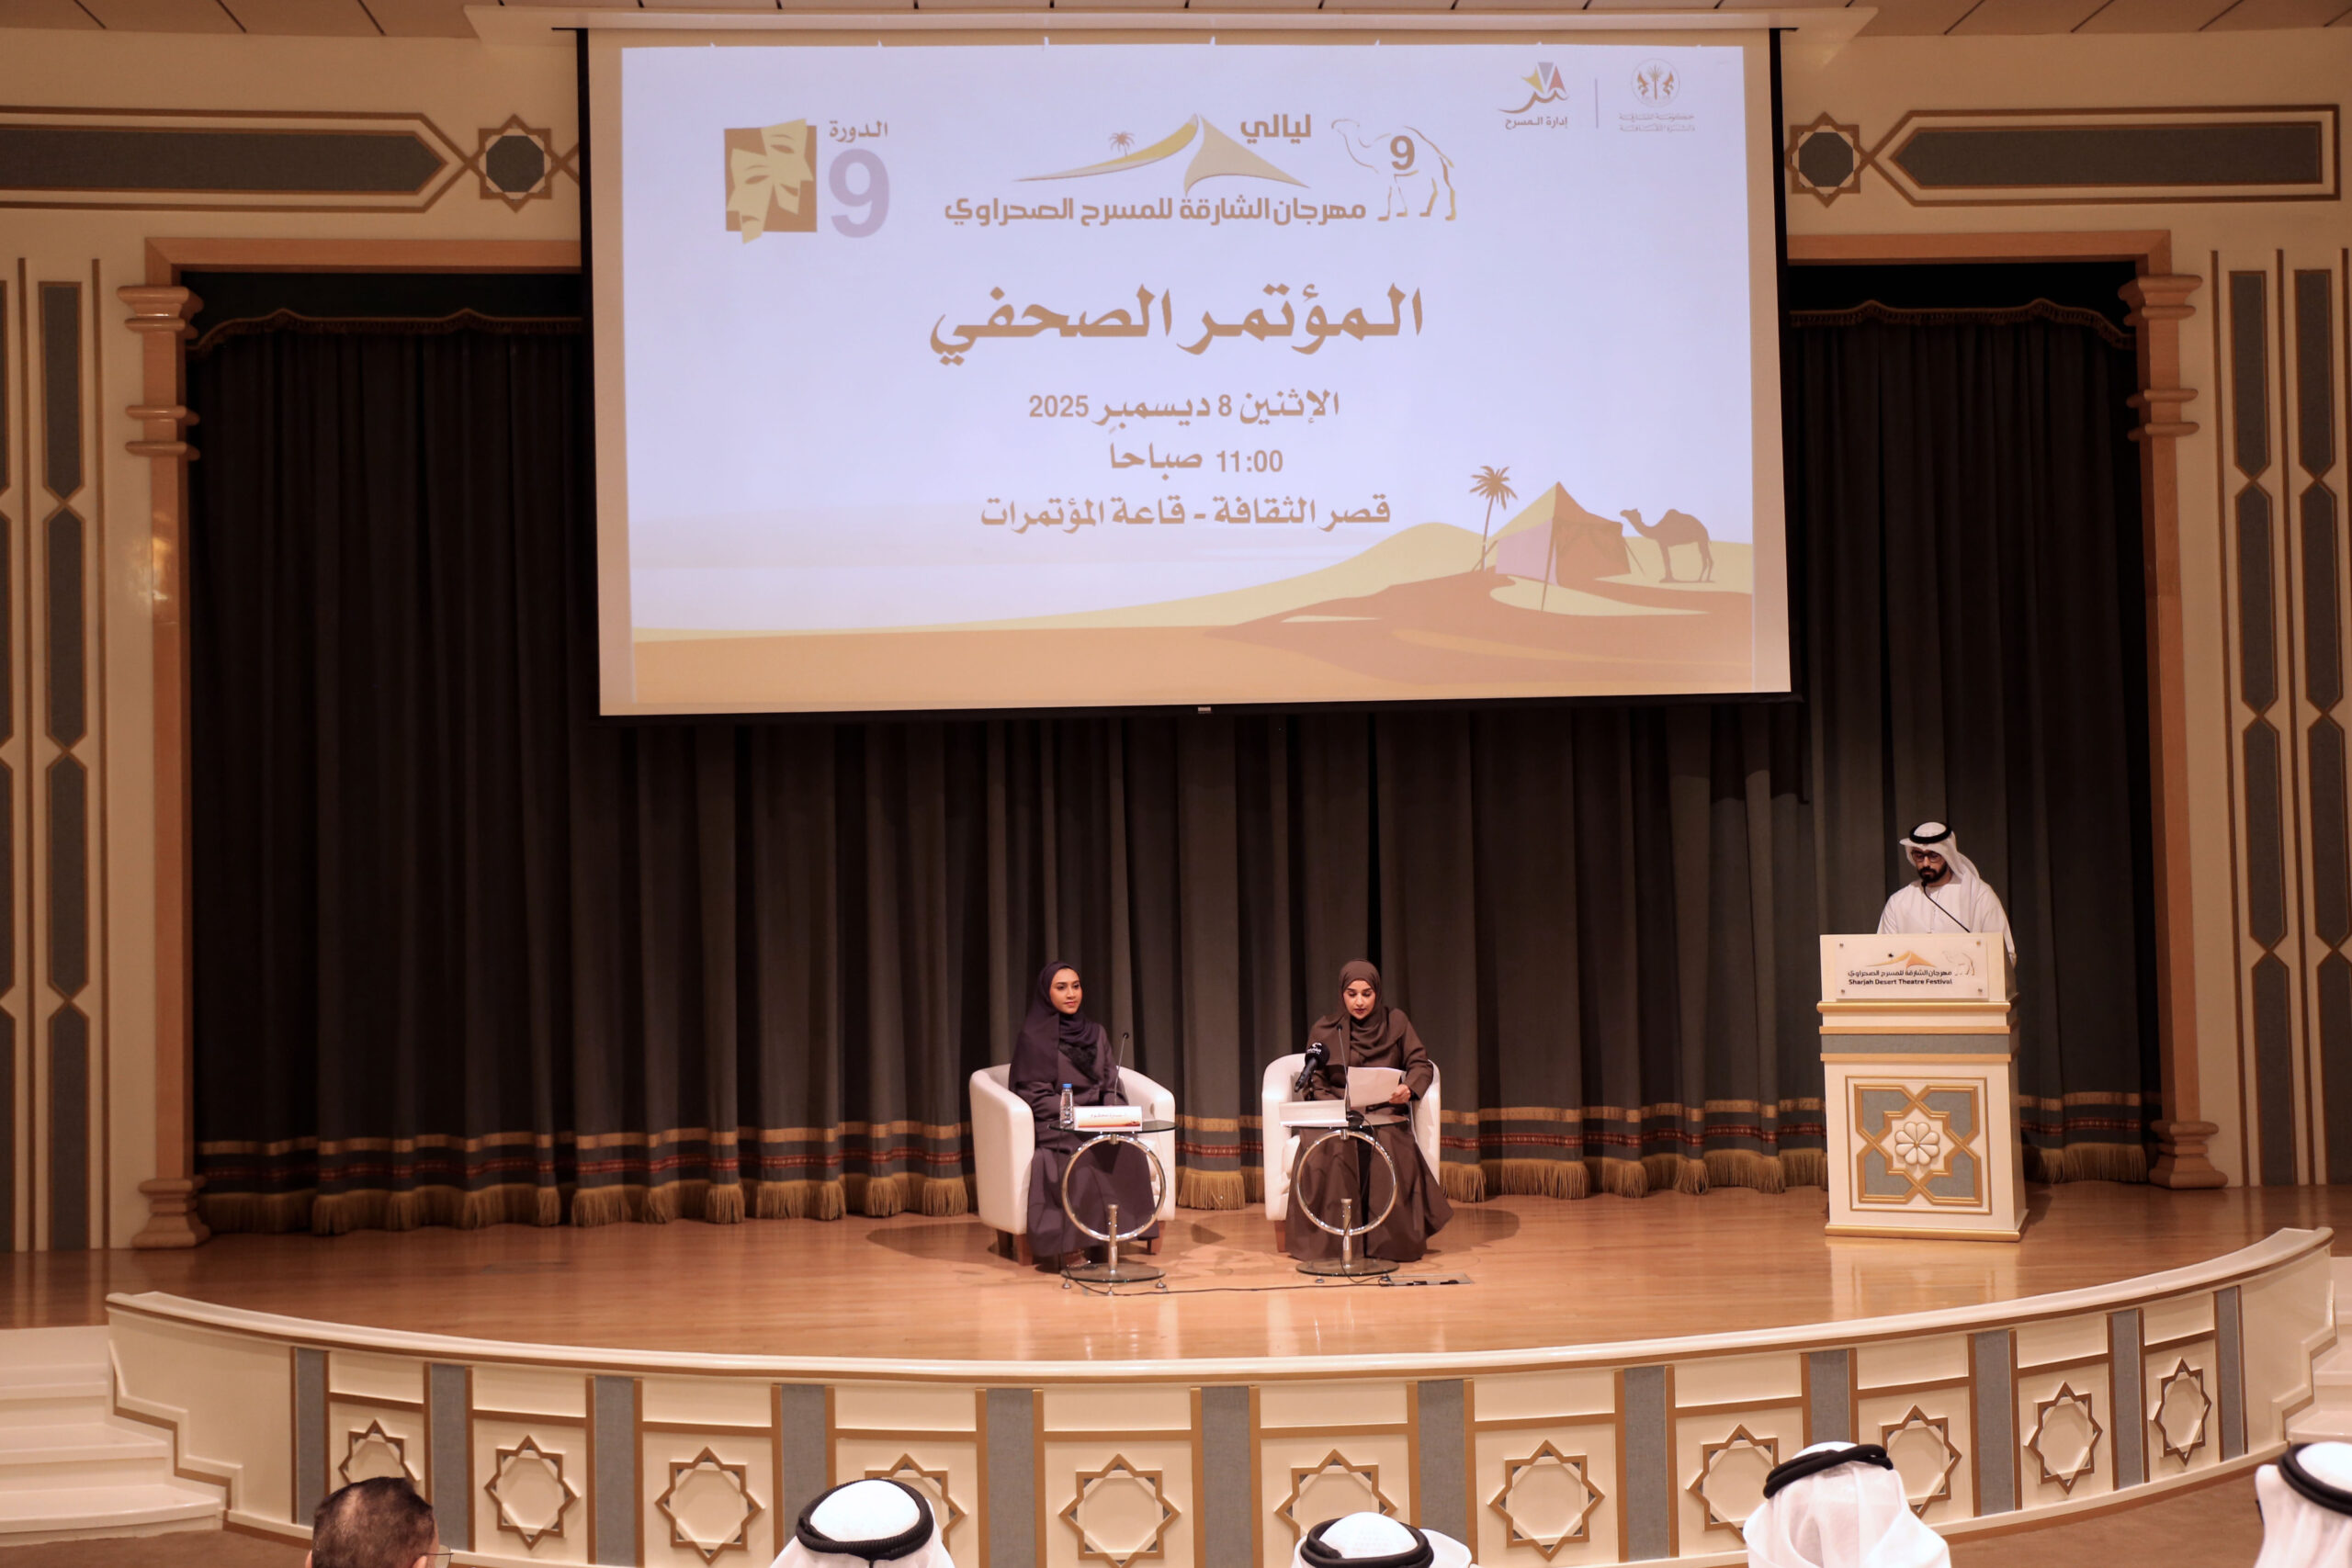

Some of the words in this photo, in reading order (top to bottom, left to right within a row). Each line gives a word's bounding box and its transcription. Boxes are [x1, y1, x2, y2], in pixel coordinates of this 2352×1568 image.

[829, 119, 888, 143] الدورة
[1240, 113, 1311, 145] ليالي
[1505, 116, 1544, 130] المسرح
[1546, 116, 1567, 129] إدارة
[1389, 134, 1416, 171] 9
[829, 148, 890, 238] 9
[1180, 191, 1271, 226] الشارقة
[944, 197, 1073, 227] الصحراوي
[1080, 197, 1173, 227] للمسرح
[1273, 197, 1367, 227] مهرجان
[929, 283, 1173, 367] الصحفي
[1176, 282, 1423, 356] المؤتمر
[1028, 394, 1090, 418] 2025
[1092, 397, 1211, 428] ديسمبر
[1217, 393, 1233, 418] 8
[1239, 388, 1340, 426] الإثنين
[1216, 449, 1283, 473] 11:00
[980, 497, 1104, 535] المؤتمرات
[1110, 494, 1186, 525] قاعة
[1212, 495, 1316, 525] الثقافة
[1317, 493, 1391, 533] قصر
